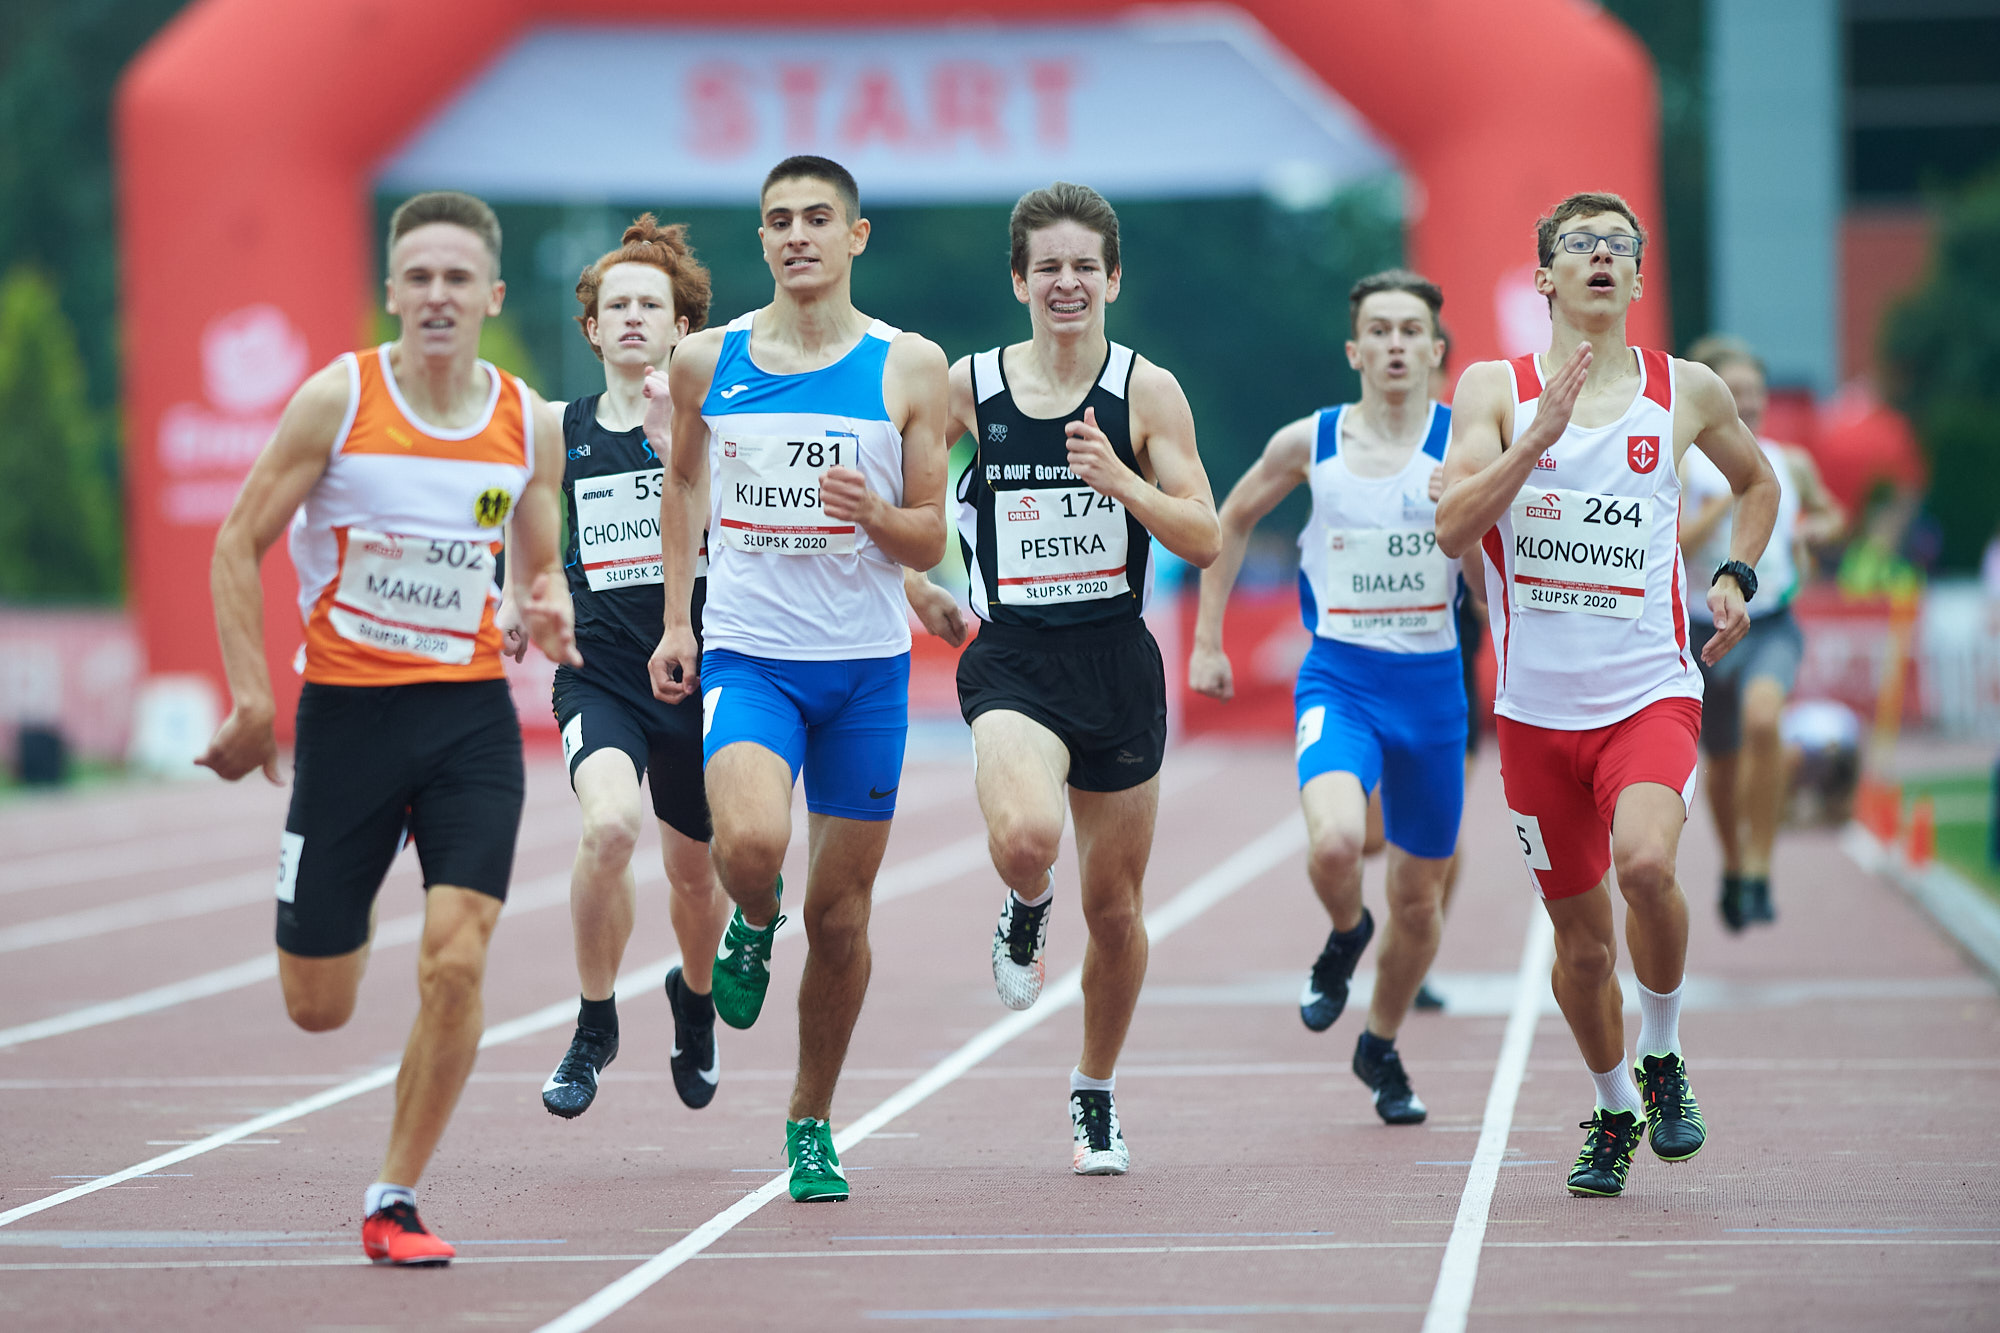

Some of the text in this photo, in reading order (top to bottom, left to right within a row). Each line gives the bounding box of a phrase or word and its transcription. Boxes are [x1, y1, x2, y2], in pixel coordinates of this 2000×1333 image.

[686, 57, 1087, 162] START
[787, 442, 844, 468] 781
[1004, 465, 1031, 480] AWF
[1009, 511, 1039, 521] ORLEN
[1060, 491, 1116, 518] 174
[1528, 507, 1559, 519] ORLEN
[1583, 498, 1642, 528] 264
[744, 534, 827, 549] SŁUPSK 2020
[1021, 534, 1106, 559] PESTKA
[1388, 532, 1436, 556] 839
[1516, 535, 1645, 570] KLONOWSKI
[426, 540, 484, 570] 502
[606, 567, 649, 582] SŁUPSK
[1353, 573, 1425, 593] BIAŁAS
[367, 574, 462, 611] MAKIŁA
[1026, 581, 1108, 599] SŁUPSK 2020
[1531, 589, 1617, 609] SŁUPSK 2020
[1352, 616, 1428, 629] SŁUPSK 2020
[359, 624, 409, 646] SŁUPSK
[414, 637, 449, 652] 2020
[1516, 824, 1532, 856] 5
